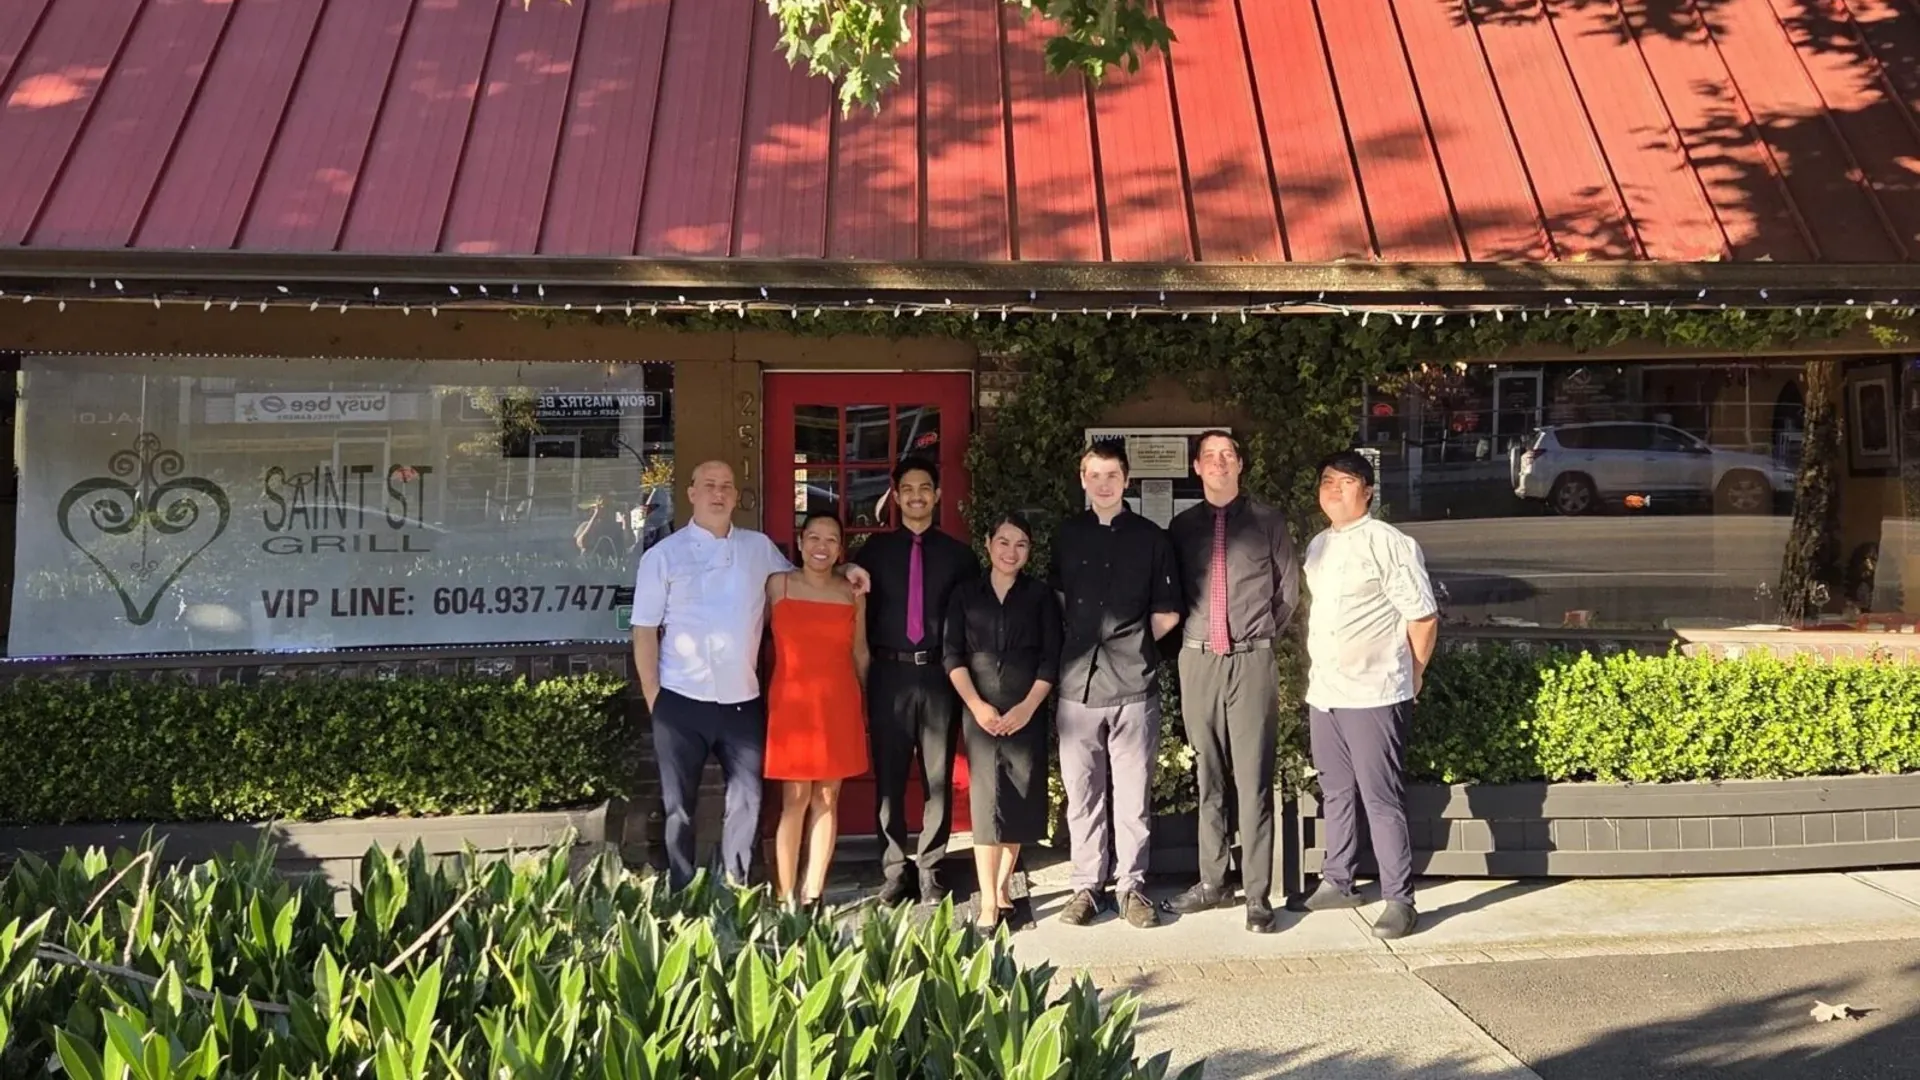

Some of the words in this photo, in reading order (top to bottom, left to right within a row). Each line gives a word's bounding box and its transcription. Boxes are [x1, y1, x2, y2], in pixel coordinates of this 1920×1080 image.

[263, 465, 374, 532] SAINT
[386, 464, 433, 531] ST
[262, 534, 431, 555] GRILL
[261, 589, 319, 619] VIP
[330, 587, 415, 617] LINE:
[433, 585, 619, 615] 604.937.7477
